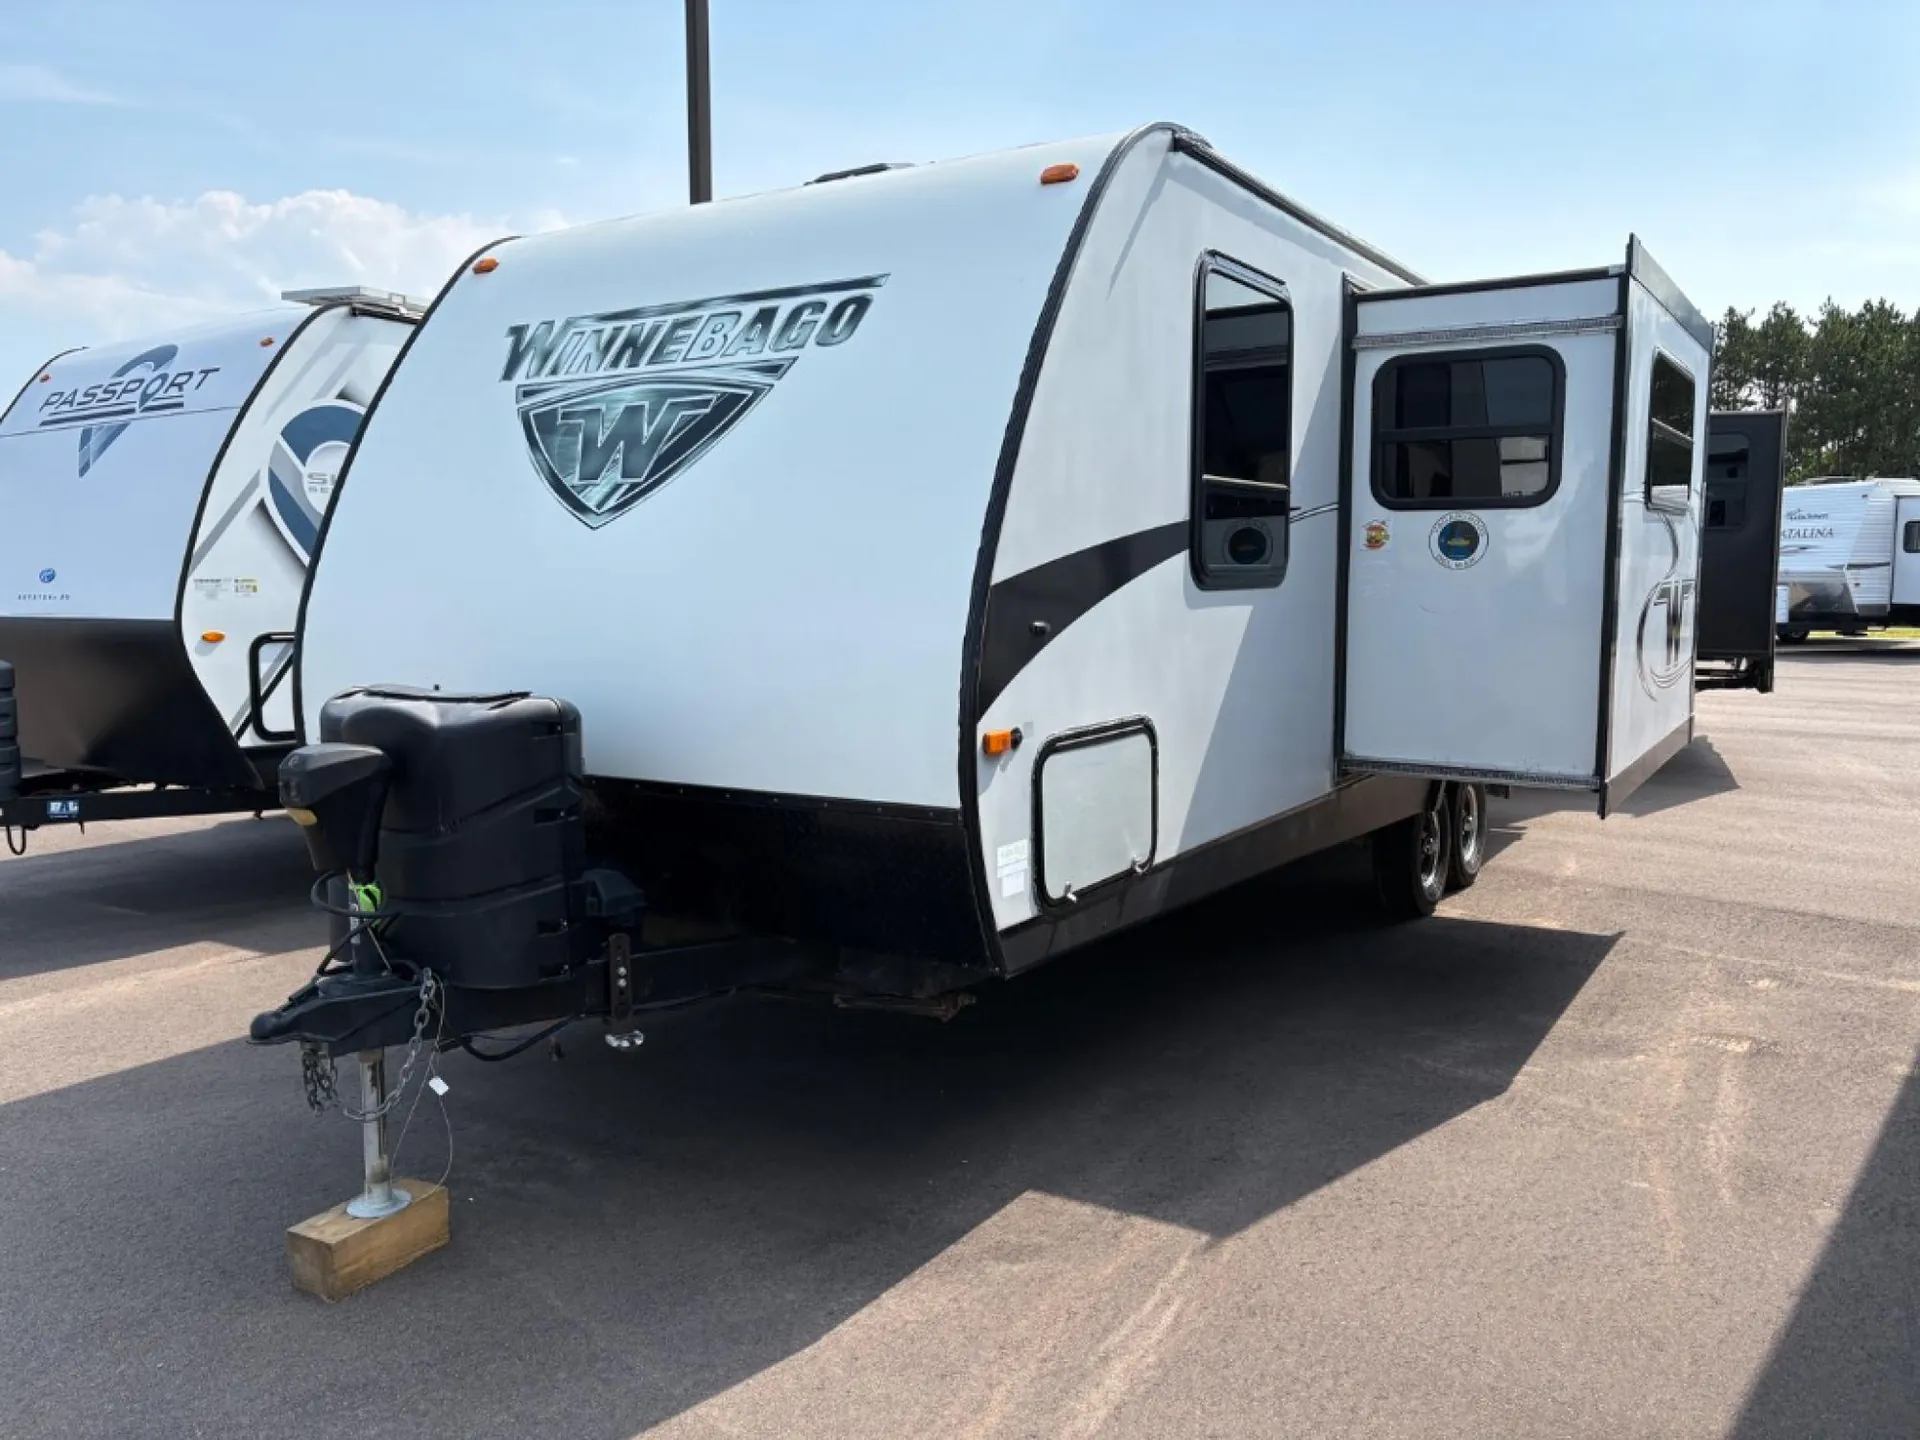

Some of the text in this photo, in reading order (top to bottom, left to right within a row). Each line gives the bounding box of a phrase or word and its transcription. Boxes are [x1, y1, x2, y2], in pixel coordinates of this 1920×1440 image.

[499, 294, 874, 382] WINNEBAGO
[39, 367, 221, 412] PASSPORT
[558, 395, 717, 484] W
